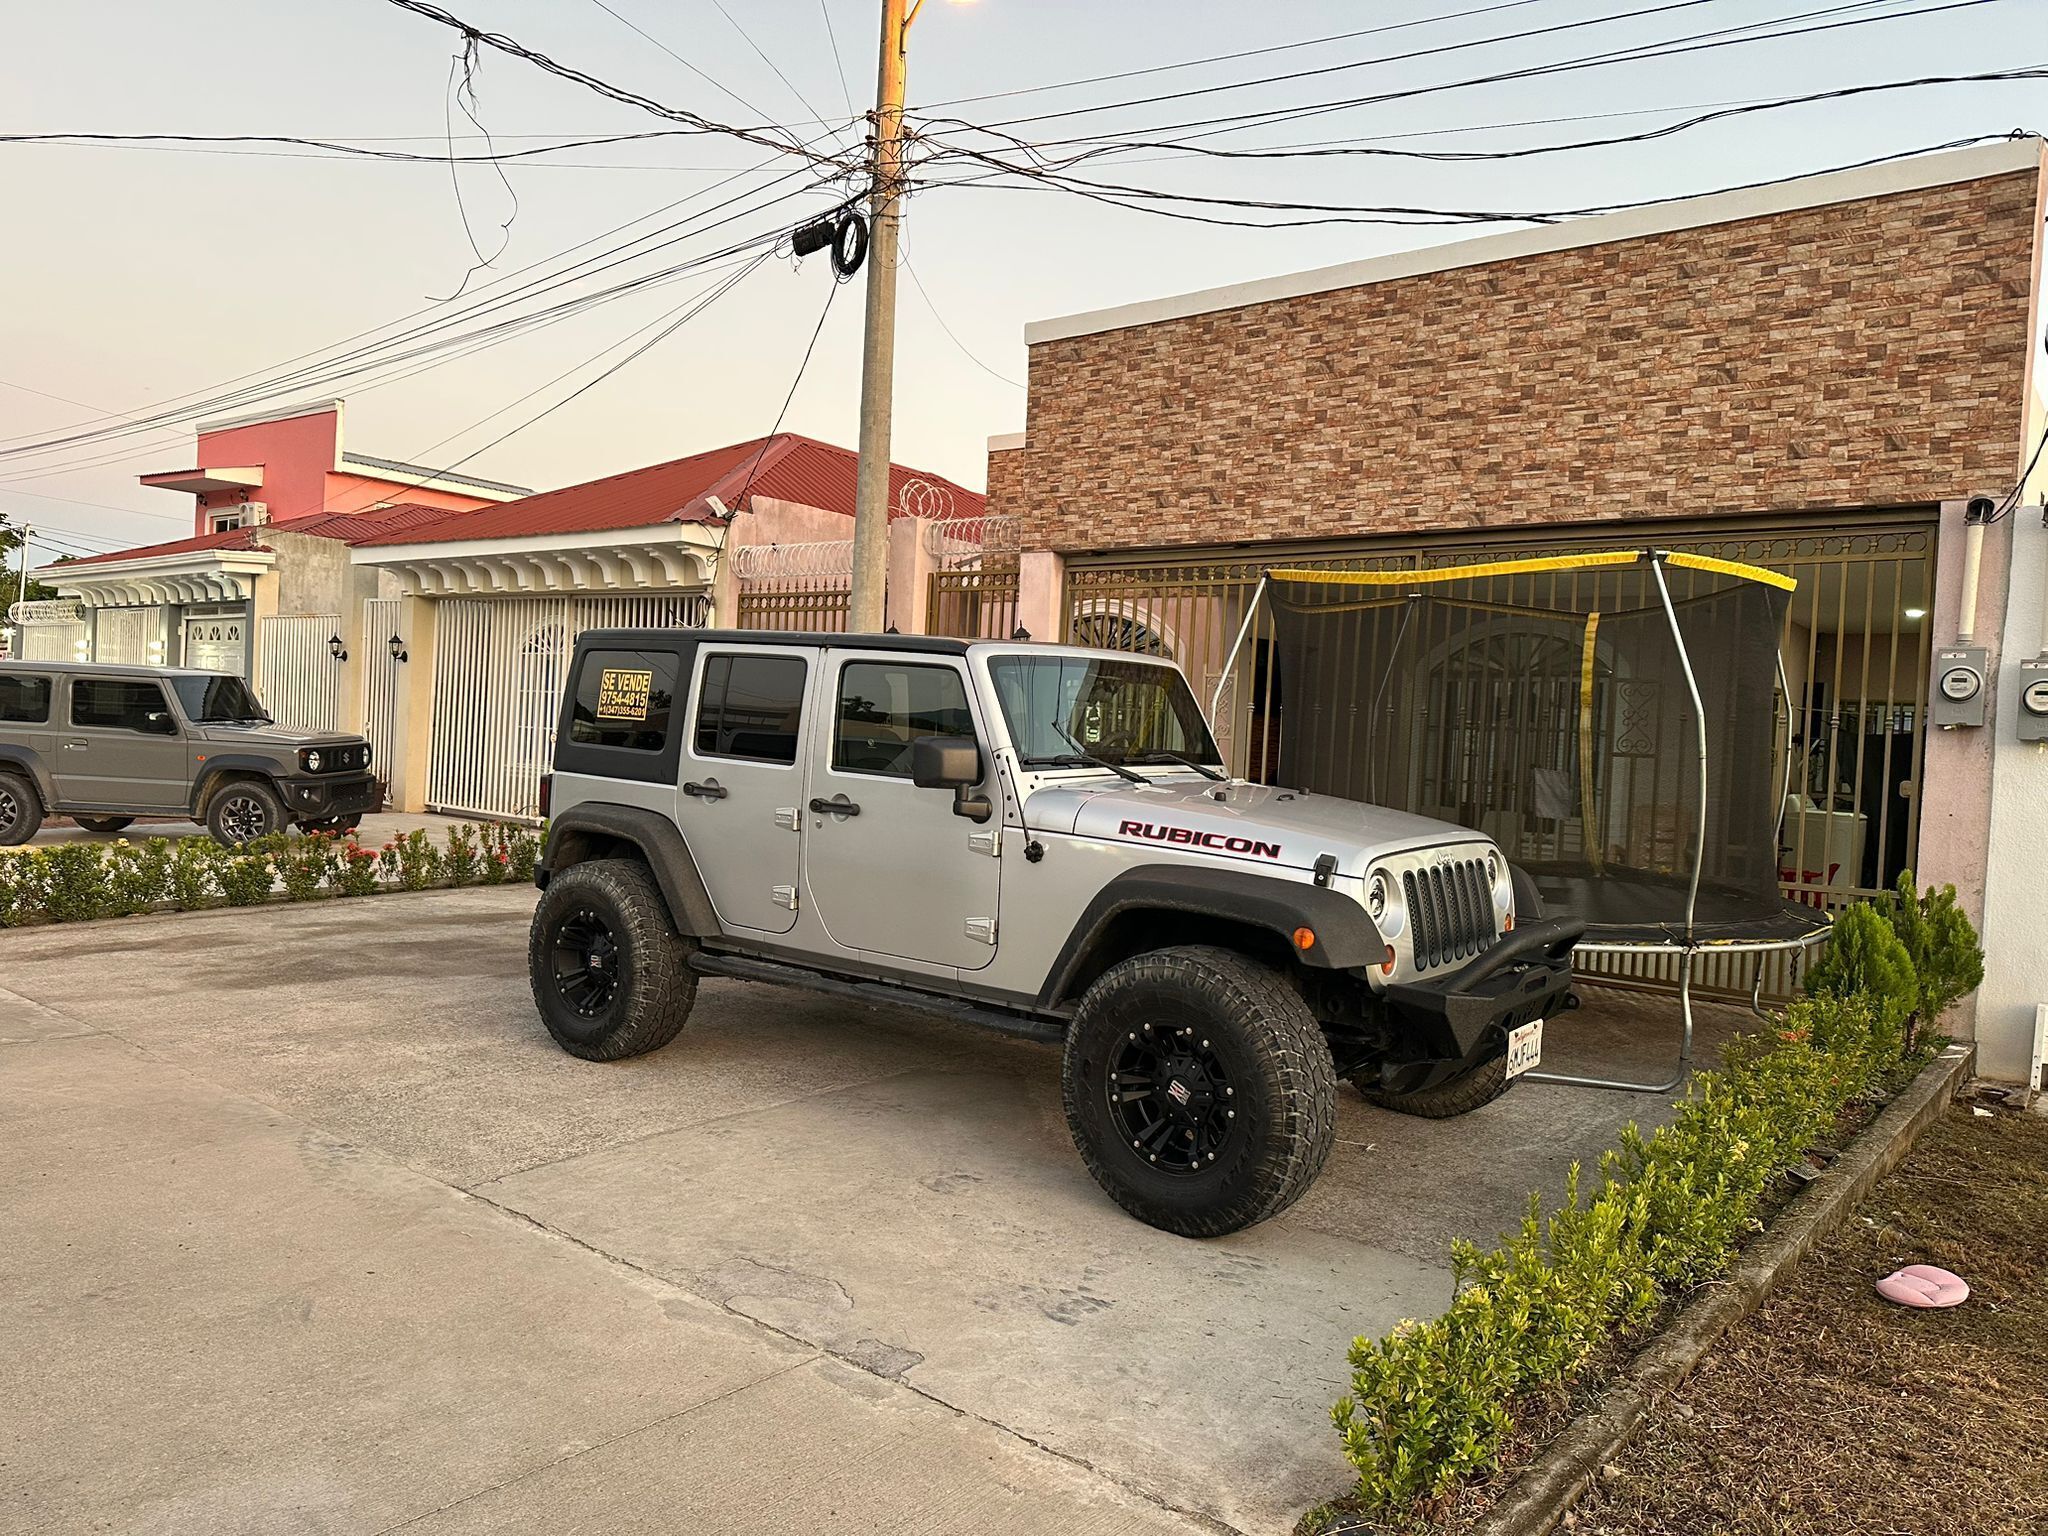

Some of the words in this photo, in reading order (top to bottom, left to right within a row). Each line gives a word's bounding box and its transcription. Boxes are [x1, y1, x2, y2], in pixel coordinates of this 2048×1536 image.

[603, 673, 616, 690] SE
[618, 673, 649, 692] VENDE
[601, 691, 646, 706] 9754-4815
[1118, 820, 1281, 859] RUBICON
